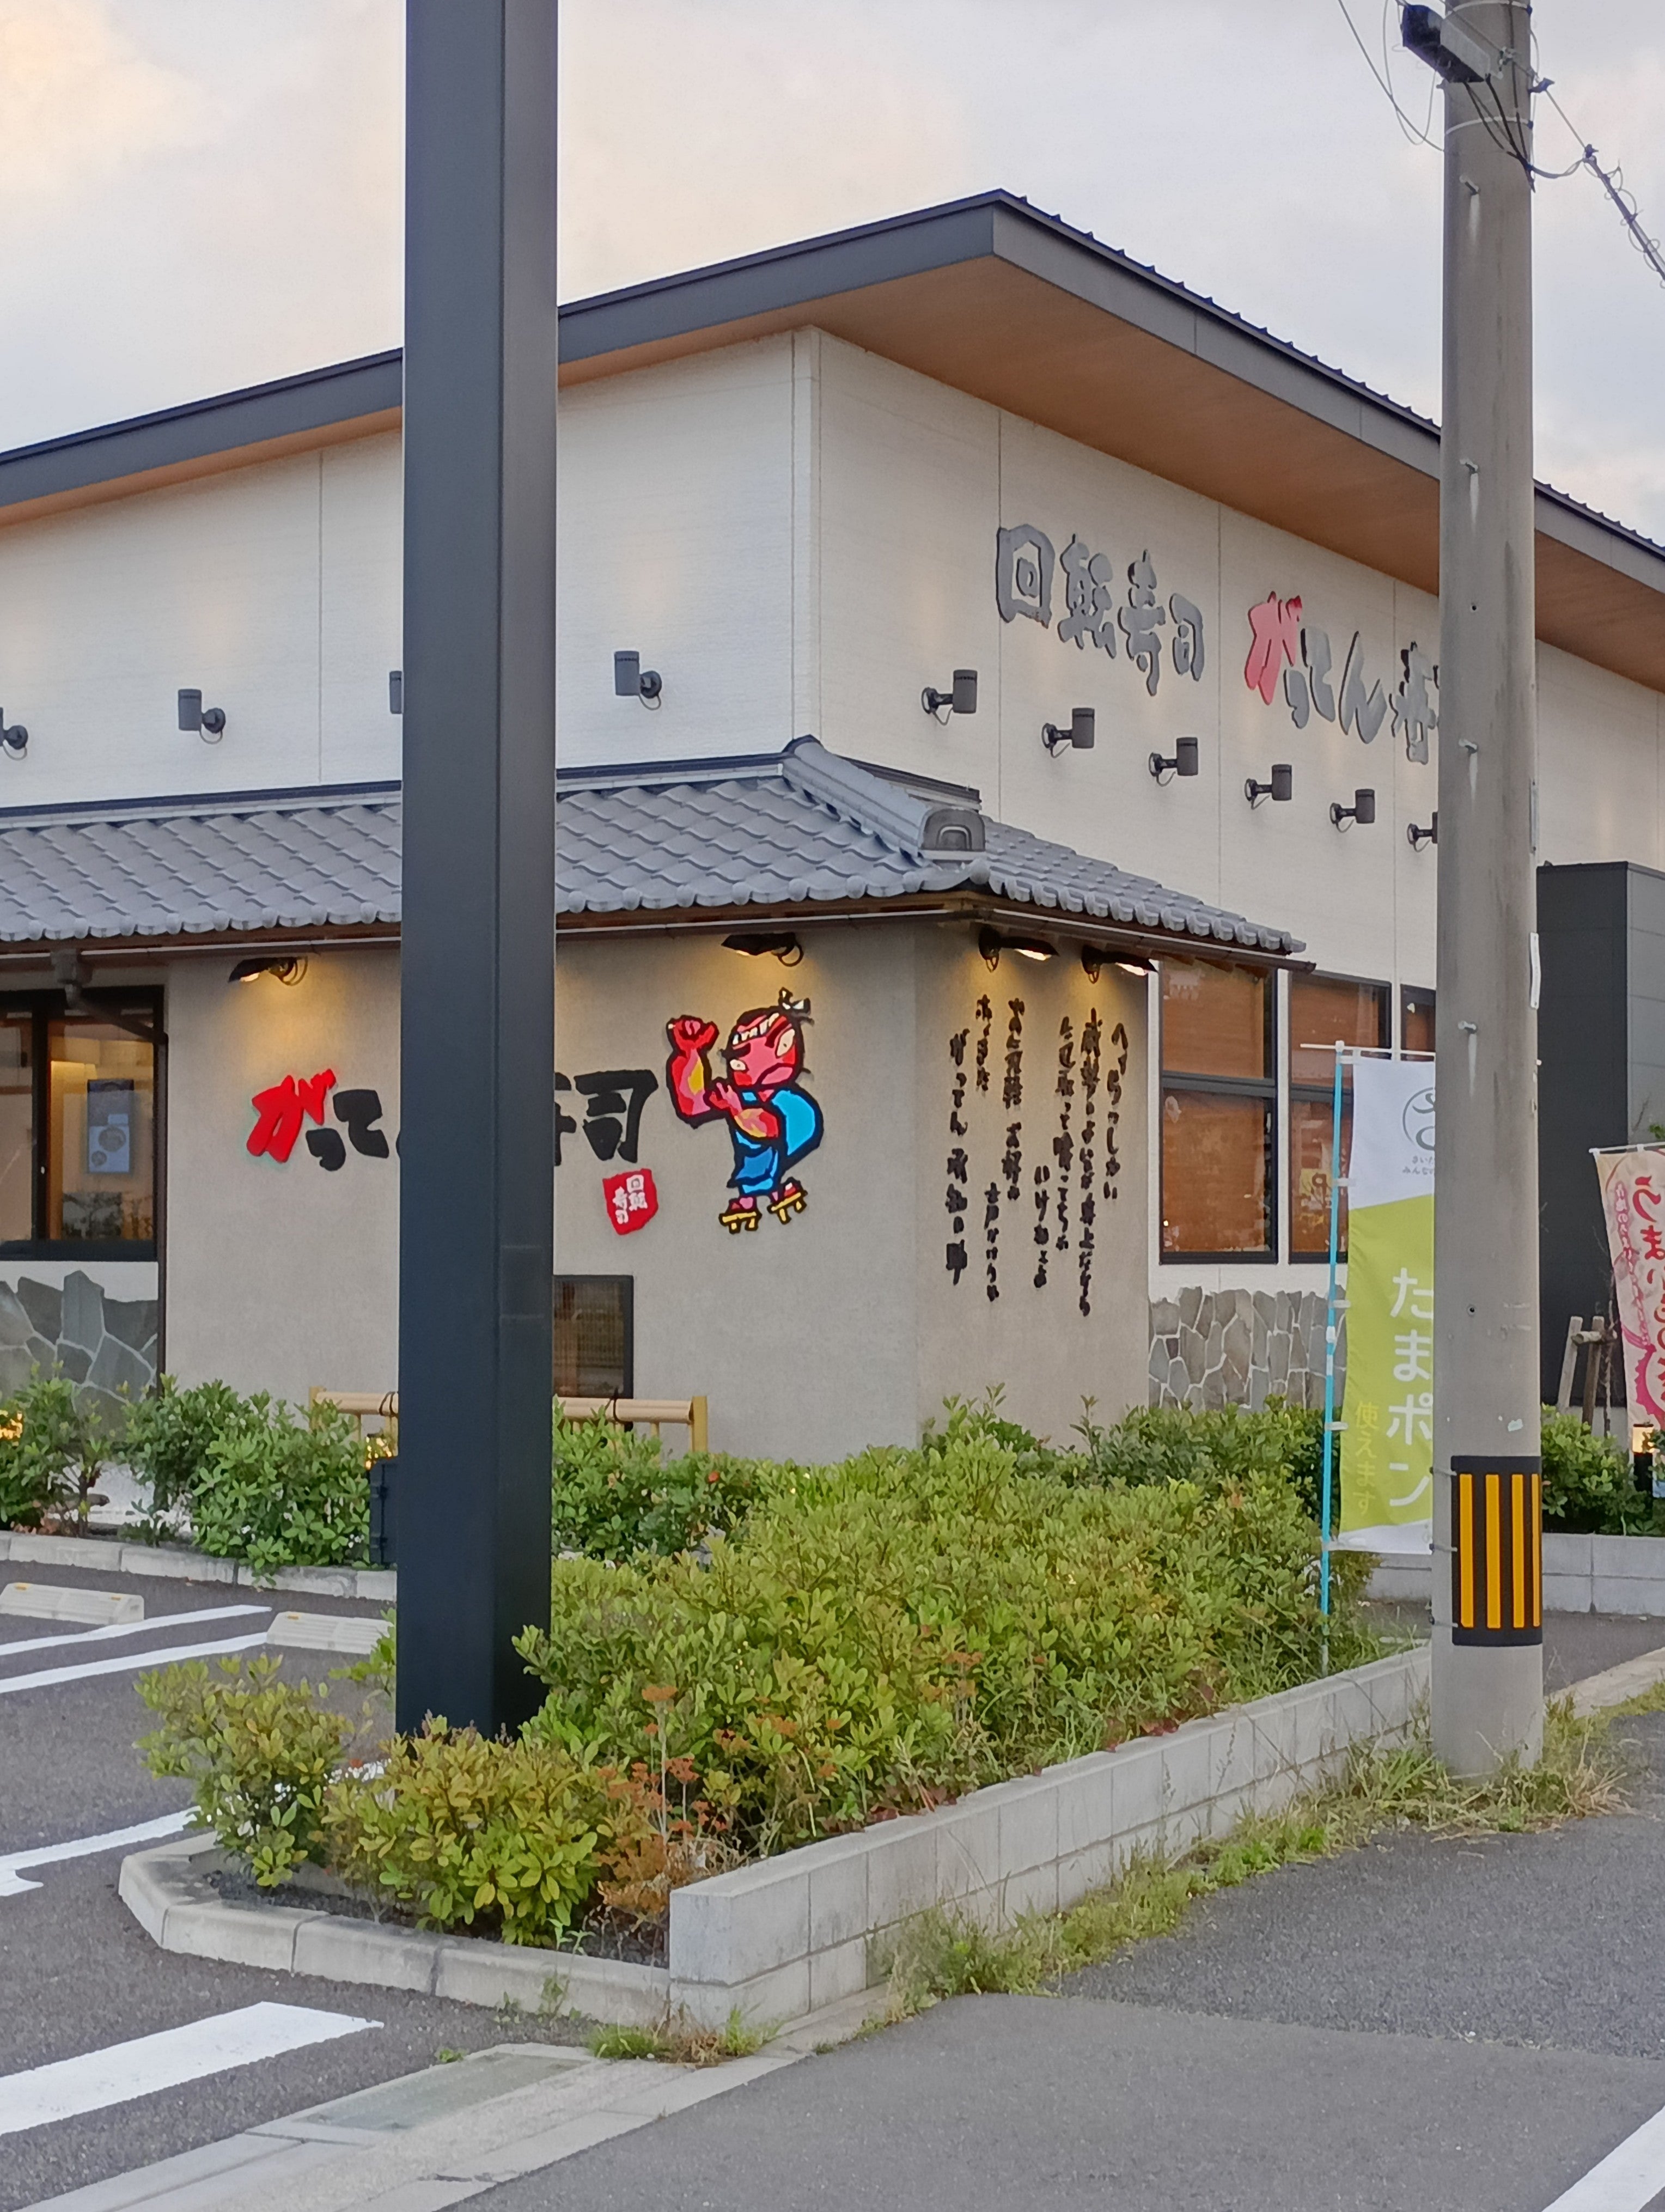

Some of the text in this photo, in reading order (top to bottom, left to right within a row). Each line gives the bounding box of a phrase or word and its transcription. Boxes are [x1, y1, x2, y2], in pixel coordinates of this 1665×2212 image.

[1244, 590, 1440, 764] がってん寿
[1386, 1267, 1434, 1508] たまポン
